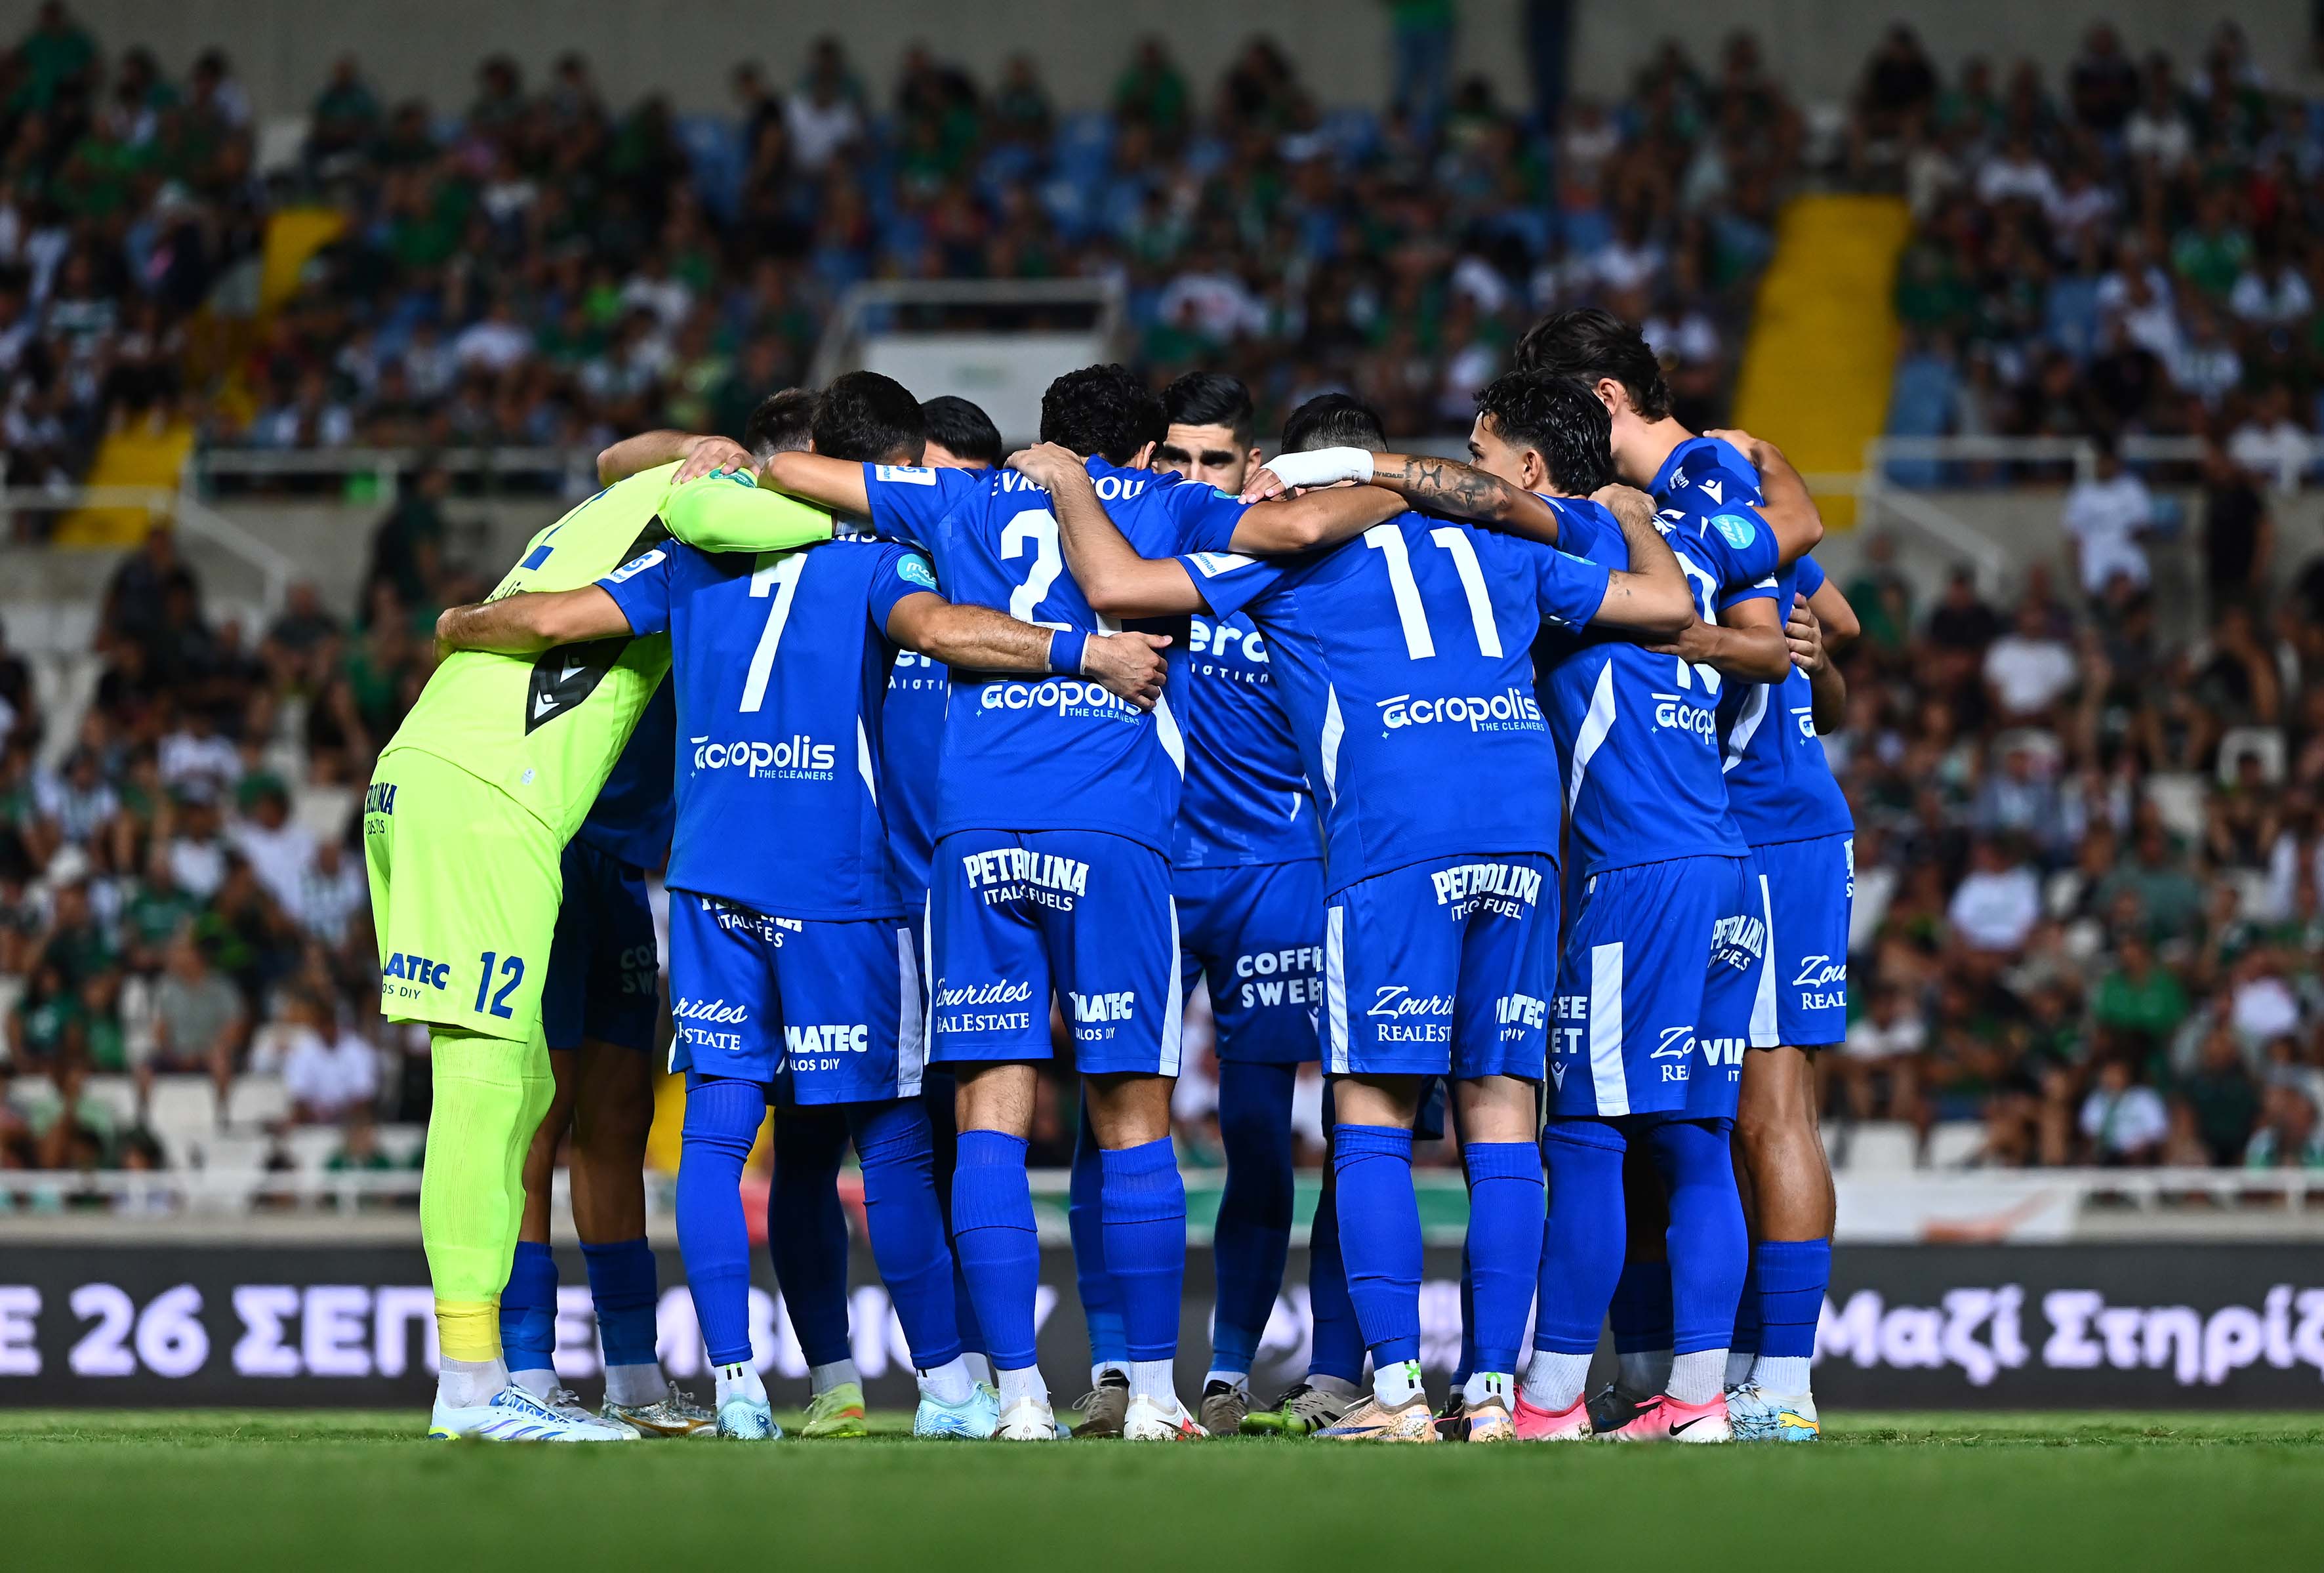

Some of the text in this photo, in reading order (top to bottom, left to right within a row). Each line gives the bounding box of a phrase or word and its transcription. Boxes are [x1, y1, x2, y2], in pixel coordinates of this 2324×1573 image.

[1364, 524, 1503, 660] 11
[739, 553, 808, 712] 7
[1069, 707, 1140, 725] THE CLEANERS
[1480, 722, 1545, 732] THE CLEANERS
[758, 769, 834, 781] THE CLEANERS
[1483, 897, 1525, 921] FUEL
[399, 987, 421, 1000] DIY
[474, 951, 525, 1019] 12
[821, 1058, 840, 1071] DIY
[68, 1281, 210, 1378] 26
